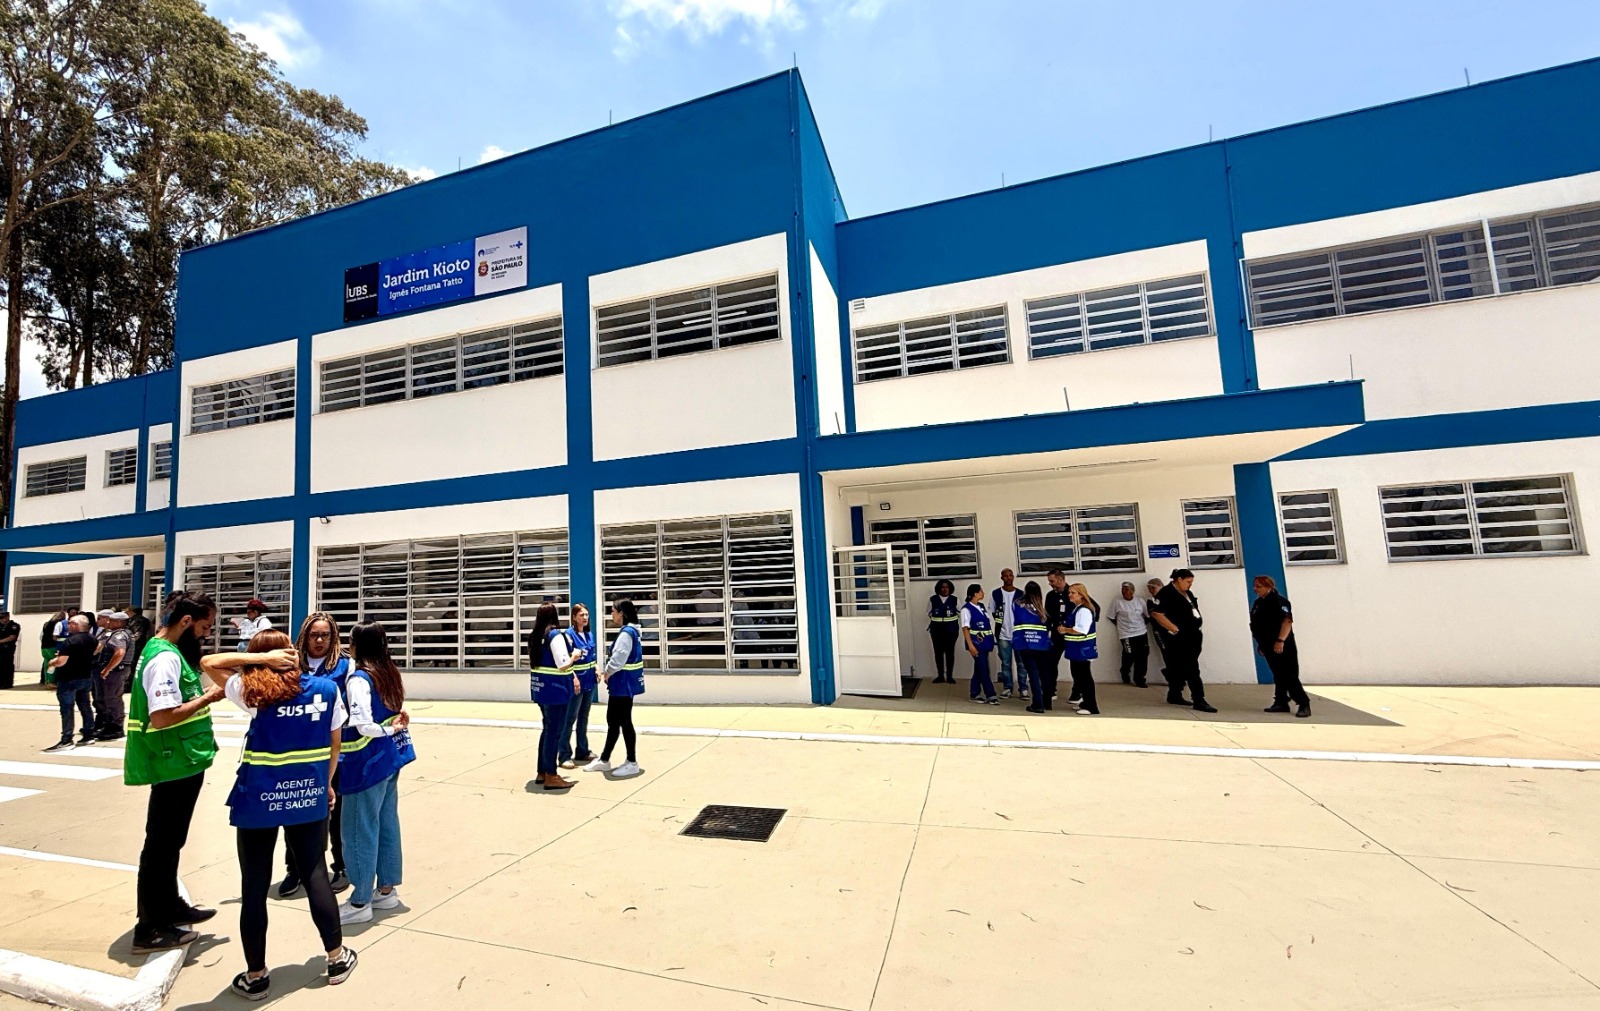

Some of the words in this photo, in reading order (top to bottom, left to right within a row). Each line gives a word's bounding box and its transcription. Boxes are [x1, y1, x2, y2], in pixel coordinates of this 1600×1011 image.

[491, 265, 503, 273] SÃO
[504, 260, 523, 270] PAULO
[383, 269, 429, 288] Jardim
[433, 259, 470, 277] Kioto
[348, 284, 368, 298] UBS
[410, 282, 441, 295] Fontana
[442, 277, 463, 287] Tatto
[277, 705, 304, 717] SUS
[275, 779, 315, 790] AGENTE
[260, 787, 325, 801] COMUNITÁRIO
[269, 802, 283, 811] DE
[285, 798, 317, 810] SAÚDE
